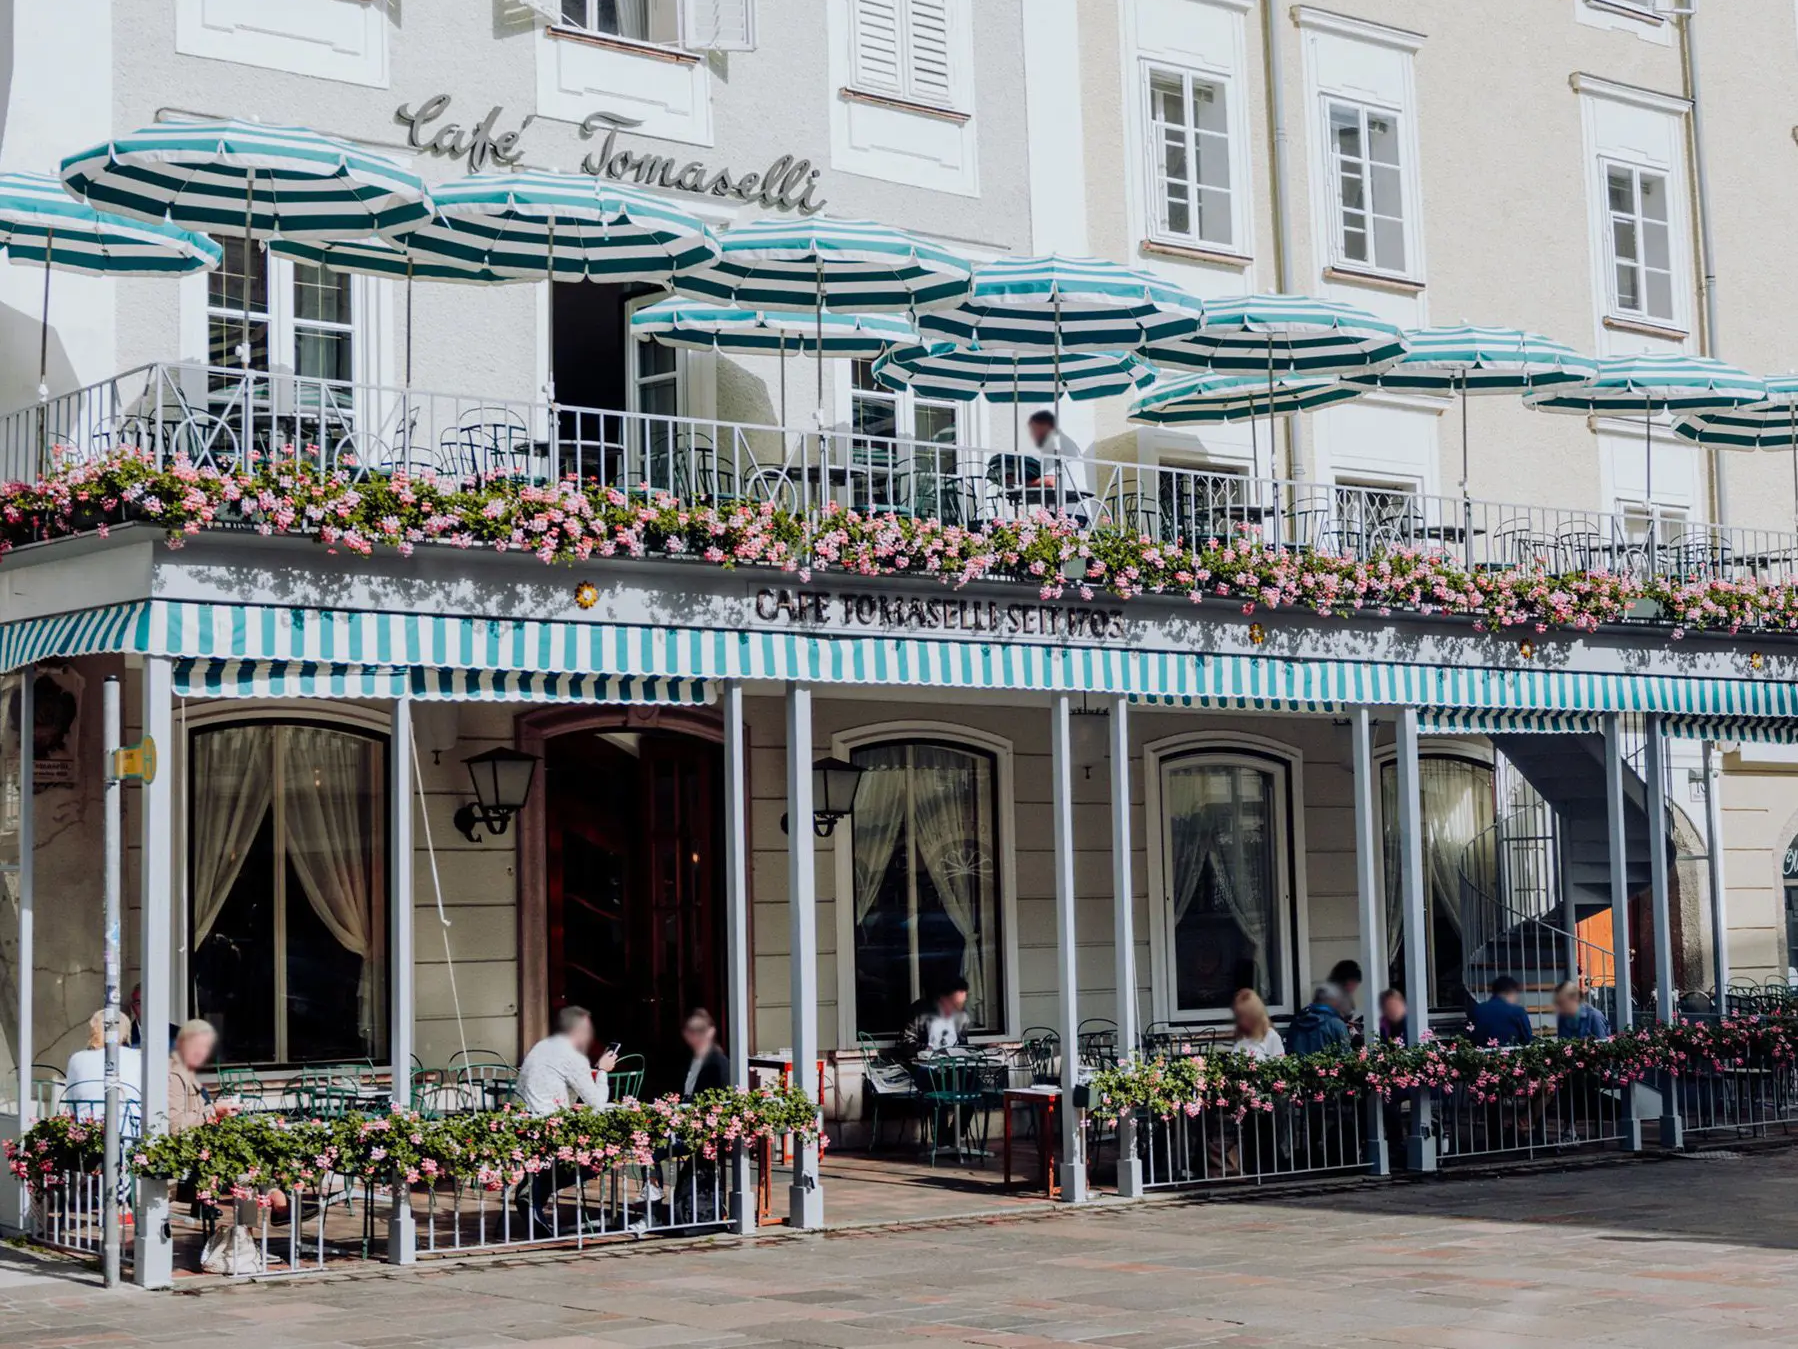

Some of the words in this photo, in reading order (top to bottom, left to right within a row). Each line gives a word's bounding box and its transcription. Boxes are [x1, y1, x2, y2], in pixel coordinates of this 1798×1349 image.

[395, 93, 537, 174] Café
[580, 111, 827, 215] Tomaselli
[756, 588, 832, 625] CAFE
[838, 592, 997, 632] TOMASELLI
[1007, 603, 1064, 635] SEIT
[1067, 606, 1126, 639] 1703
